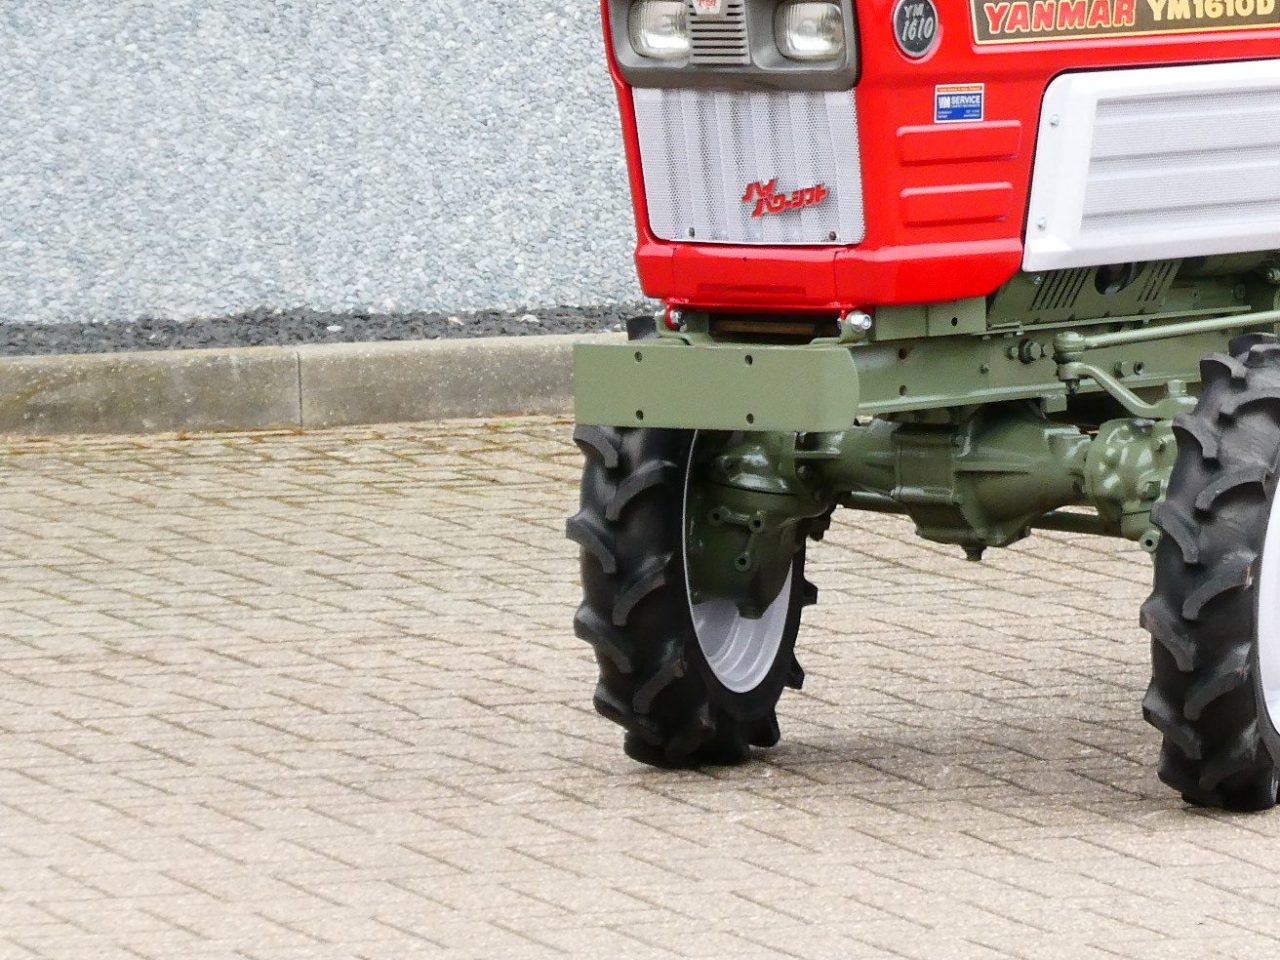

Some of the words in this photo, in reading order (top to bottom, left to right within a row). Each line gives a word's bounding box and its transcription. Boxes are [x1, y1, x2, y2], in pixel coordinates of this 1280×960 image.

[904, 3, 925, 18] YM
[902, 16, 934, 41] 1610
[951, 95, 981, 105] SERVICE
